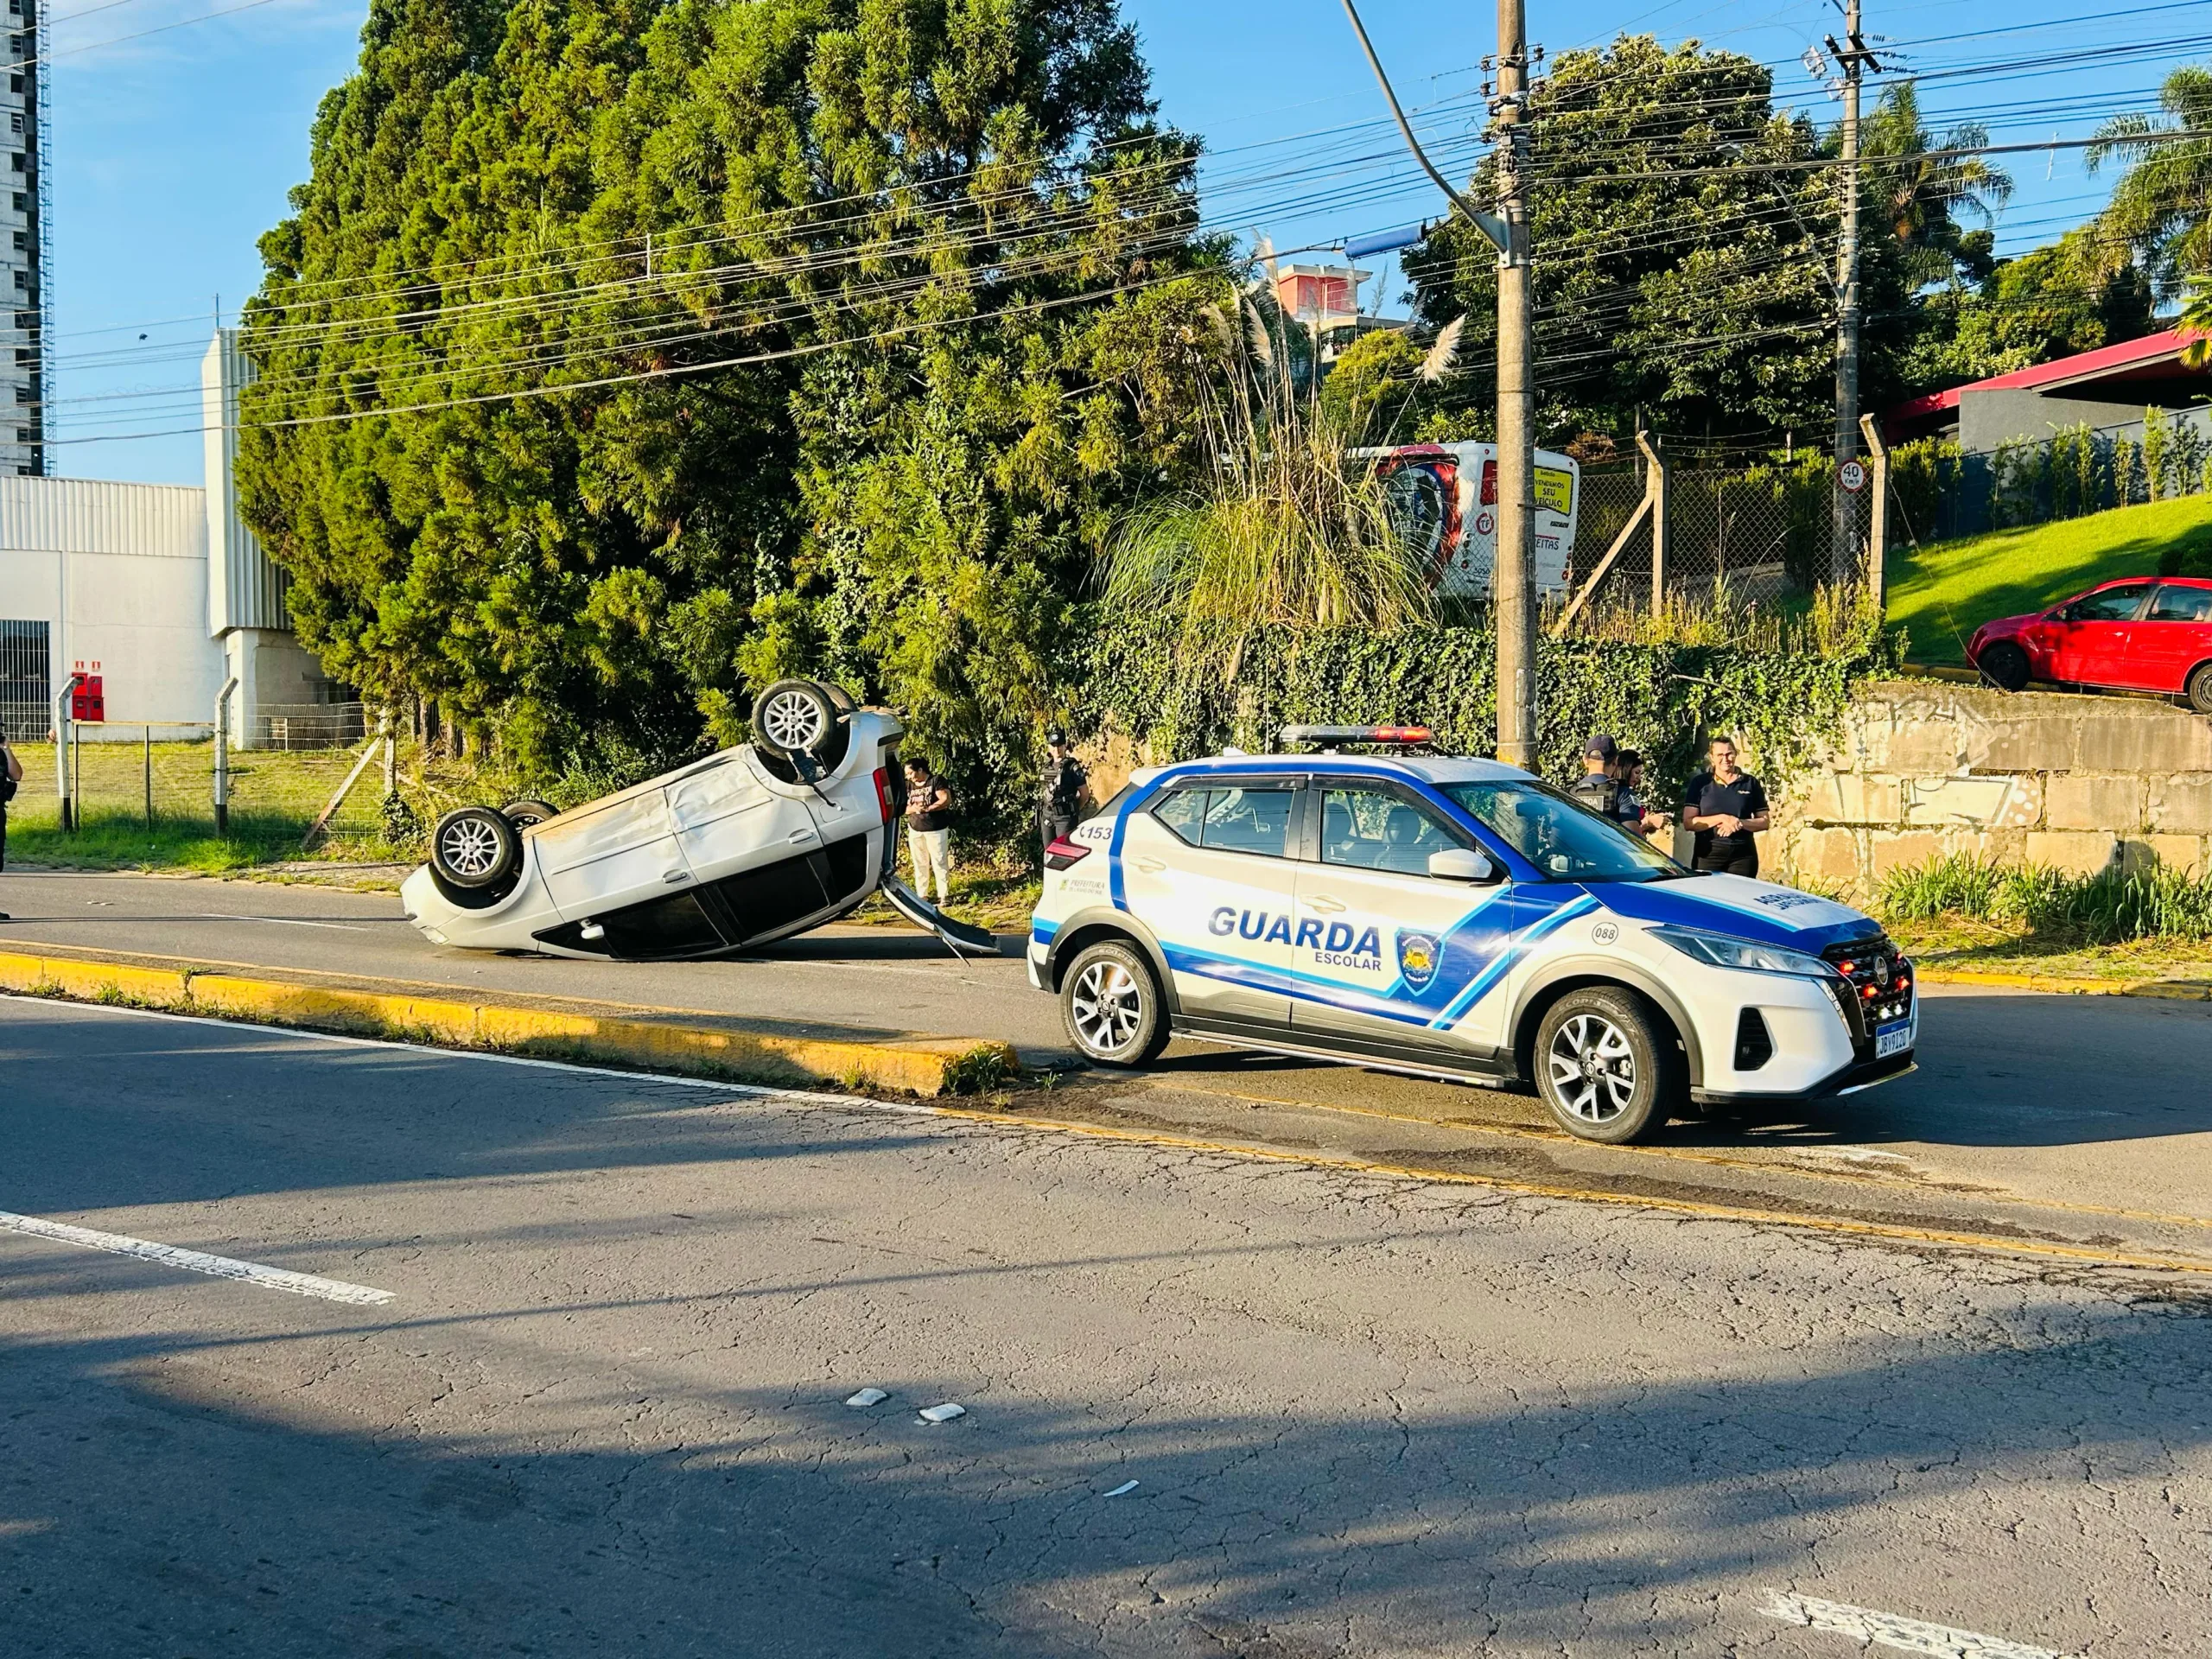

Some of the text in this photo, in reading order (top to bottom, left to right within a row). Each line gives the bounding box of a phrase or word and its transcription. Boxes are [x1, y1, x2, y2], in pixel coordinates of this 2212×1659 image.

[1843, 465, 1859, 477] 40
[1535, 479, 1565, 489] VENDEMOS
[1542, 487, 1556, 496] SEU
[1535, 538, 1560, 550] EITAS
[1087, 826, 1113, 840] 153
[1208, 906, 1382, 959] GUARDA
[1595, 927, 1616, 939] 088
[1315, 951, 1382, 972] ESCOLAR
